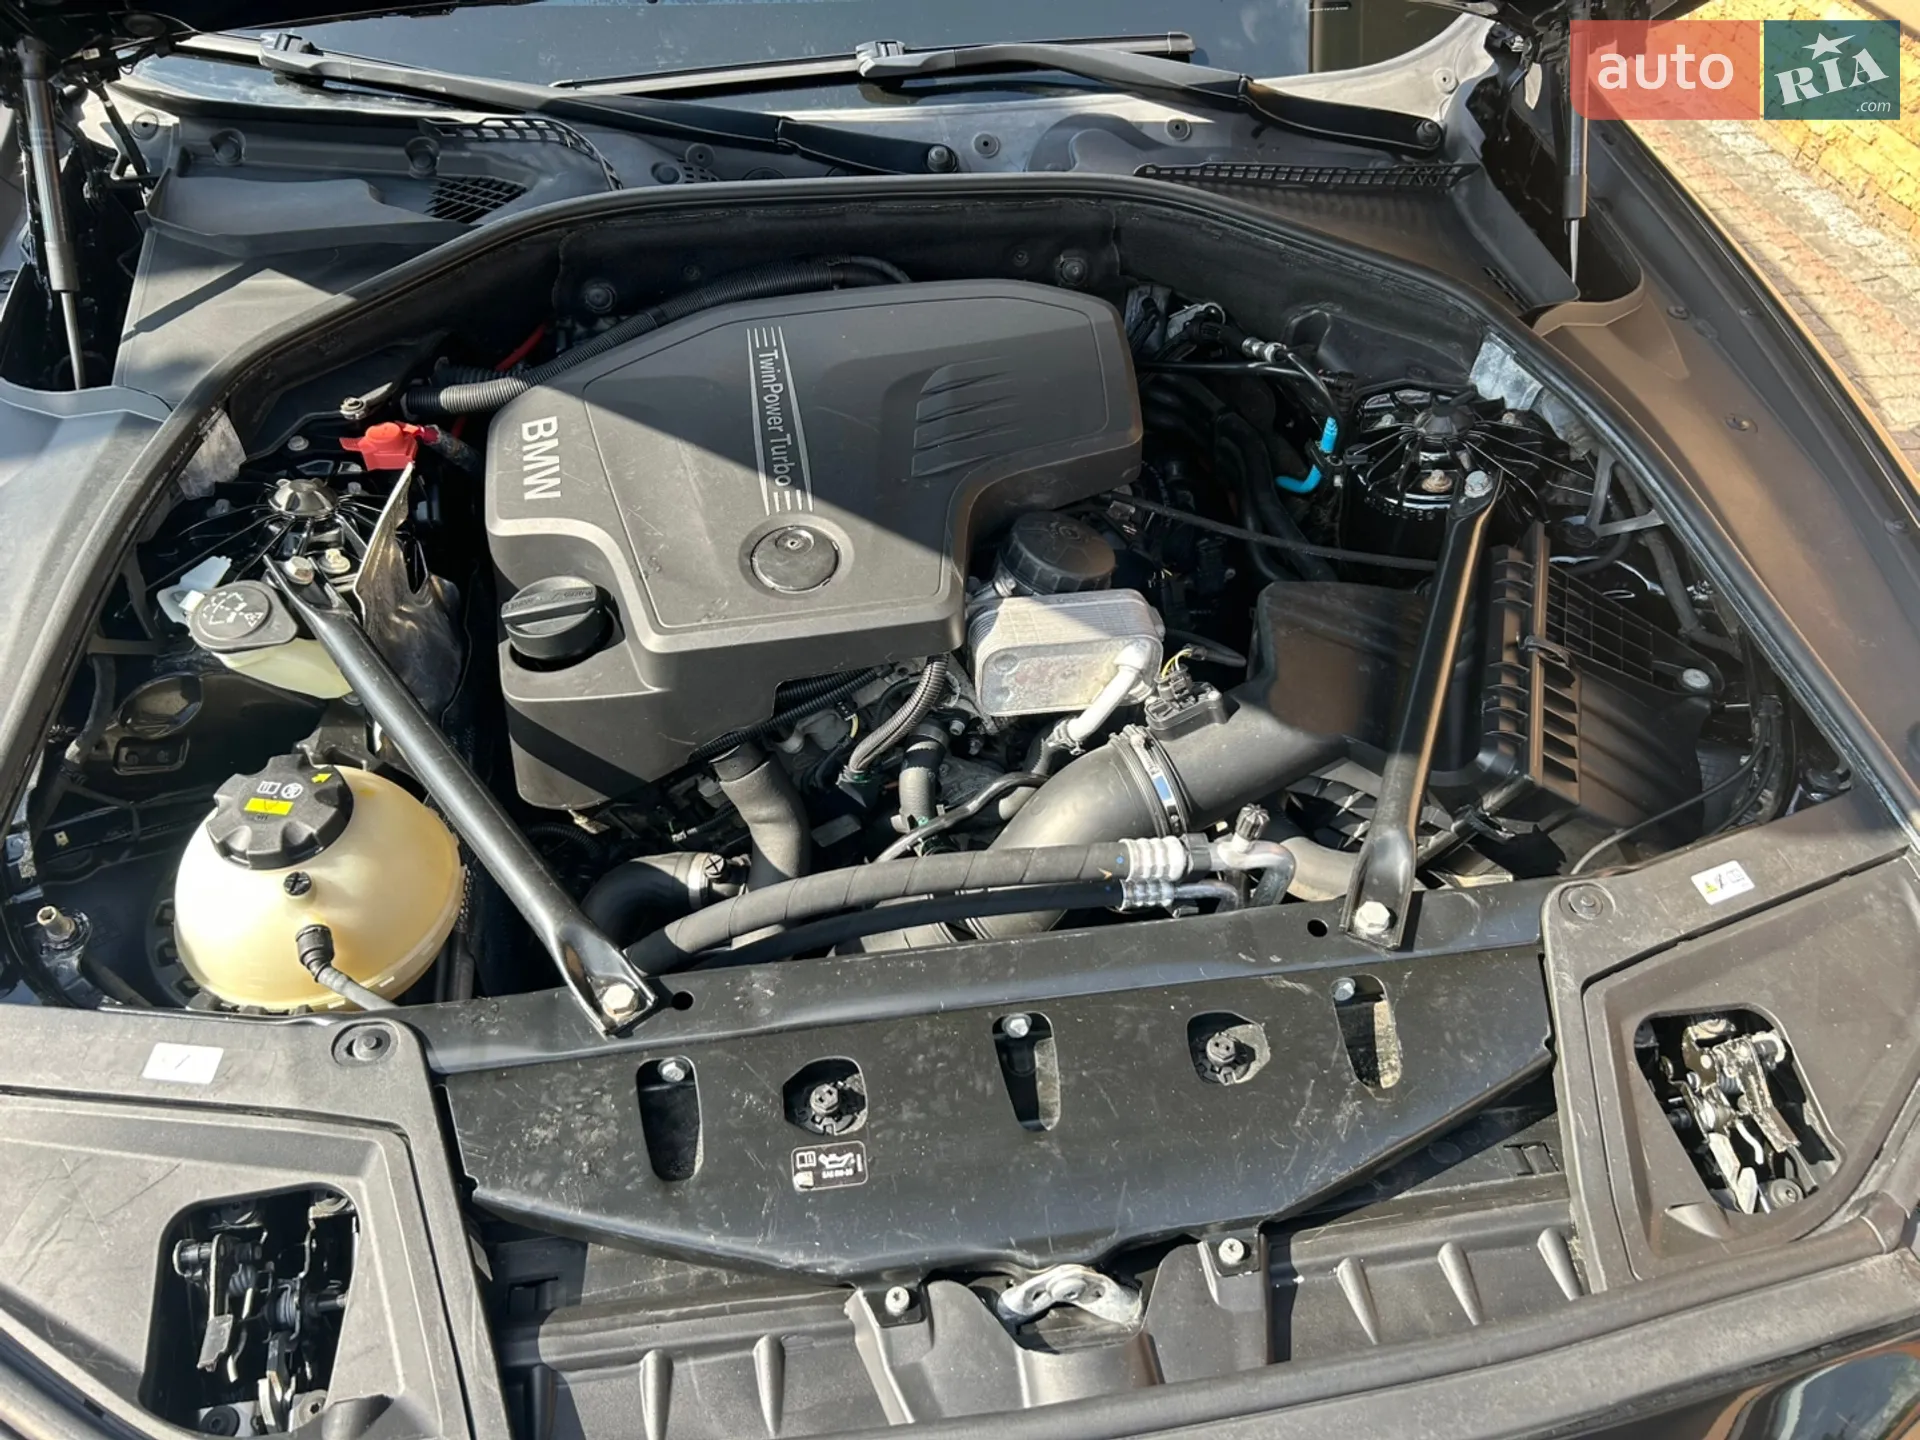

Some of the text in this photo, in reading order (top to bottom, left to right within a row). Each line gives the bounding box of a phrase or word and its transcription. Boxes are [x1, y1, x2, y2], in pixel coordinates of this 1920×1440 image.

[521, 415, 562, 500] BMW
[758, 349, 796, 487] TwinPower Turbo
